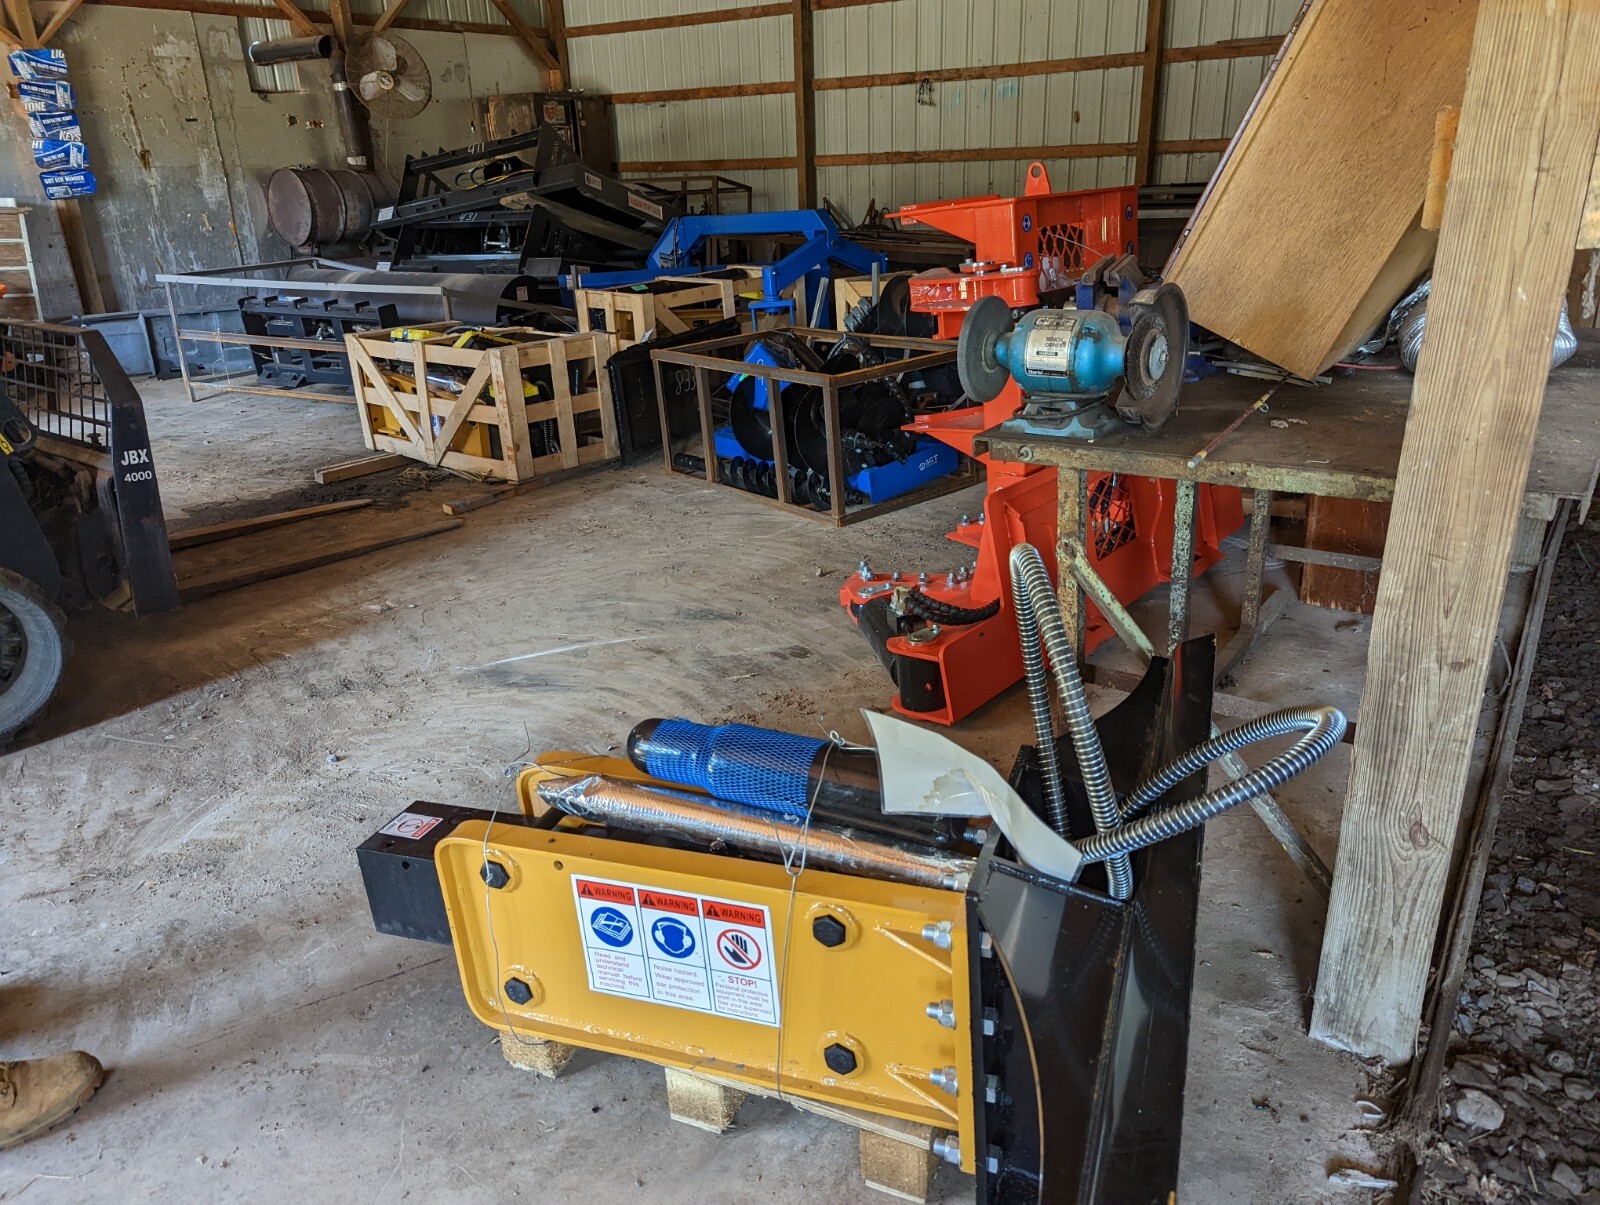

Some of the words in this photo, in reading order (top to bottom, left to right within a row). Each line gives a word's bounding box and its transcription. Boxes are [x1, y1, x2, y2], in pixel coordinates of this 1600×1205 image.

[24, 102, 46, 112] TONE
[60, 130, 81, 142] KEYS
[32, 140, 44, 149] HT
[459, 212, 478, 222] 431
[120, 449, 150, 466] JBX
[124, 471, 152, 482] 4000
[594, 884, 632, 901] WARNING
[656, 895, 695, 912] WARNING
[720, 906, 762, 924] WARNING
[596, 959, 629, 968] understand
[597, 964, 623, 972] technical
[654, 964, 672, 972] Noise
[599, 976, 625, 985] servicing
[674, 978, 704, 987] approved
[728, 976, 758, 988] STOP!
[669, 984, 701, 994] protection
[715, 982, 740, 992] Personal
[741, 988, 768, 997] protective
[716, 989, 745, 998] equipment
[744, 1005, 772, 1014] supervisor
